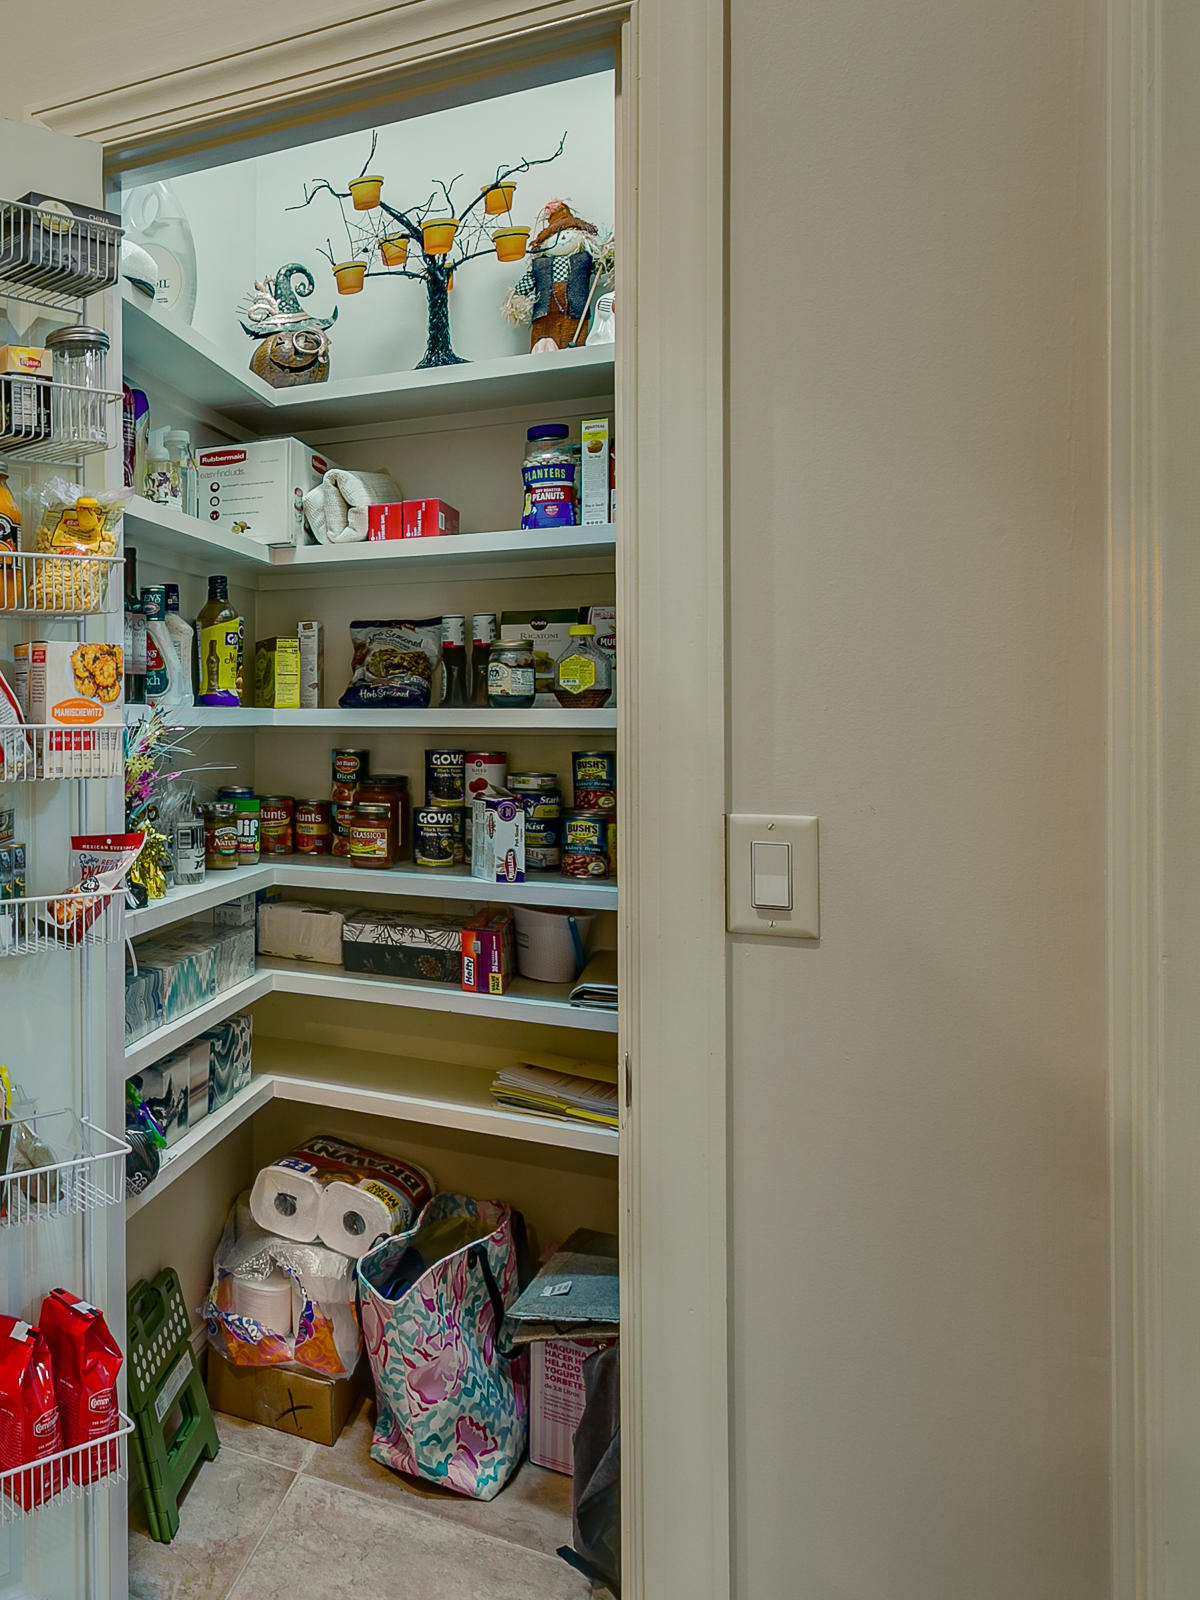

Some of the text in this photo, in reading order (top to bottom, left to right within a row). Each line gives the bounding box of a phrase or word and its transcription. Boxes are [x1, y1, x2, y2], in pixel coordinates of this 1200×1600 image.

[19, 357, 41, 368] Lipton
[201, 452, 245, 464] Rubbermaid
[524, 467, 566, 481] PLANTERS
[532, 491, 565, 502] PEANUTS
[384, 630, 424, 649] Seasoned
[358, 689, 377, 698] Herb
[54, 707, 103, 717] MANISCHEWITZ
[432, 754, 464, 765] GOYA
[576, 759, 606, 770] BUSH'S
[419, 812, 453, 824] GOYA
[236, 819, 258, 836] Jif
[353, 830, 382, 839] CLASSICO
[567, 824, 598, 834] BUSH'S
[465, 958, 474, 984] Hefty
[304, 1142, 424, 1198] BRAWNY
[131, 1171, 148, 1189] 26
[369, 1182, 400, 1209] MORE
[544, 1341, 587, 1358] MAQUINA
[544, 1349, 574, 1363] HACER
[544, 1357, 581, 1373] HELADO
[544, 1365, 581, 1381] YOGURT
